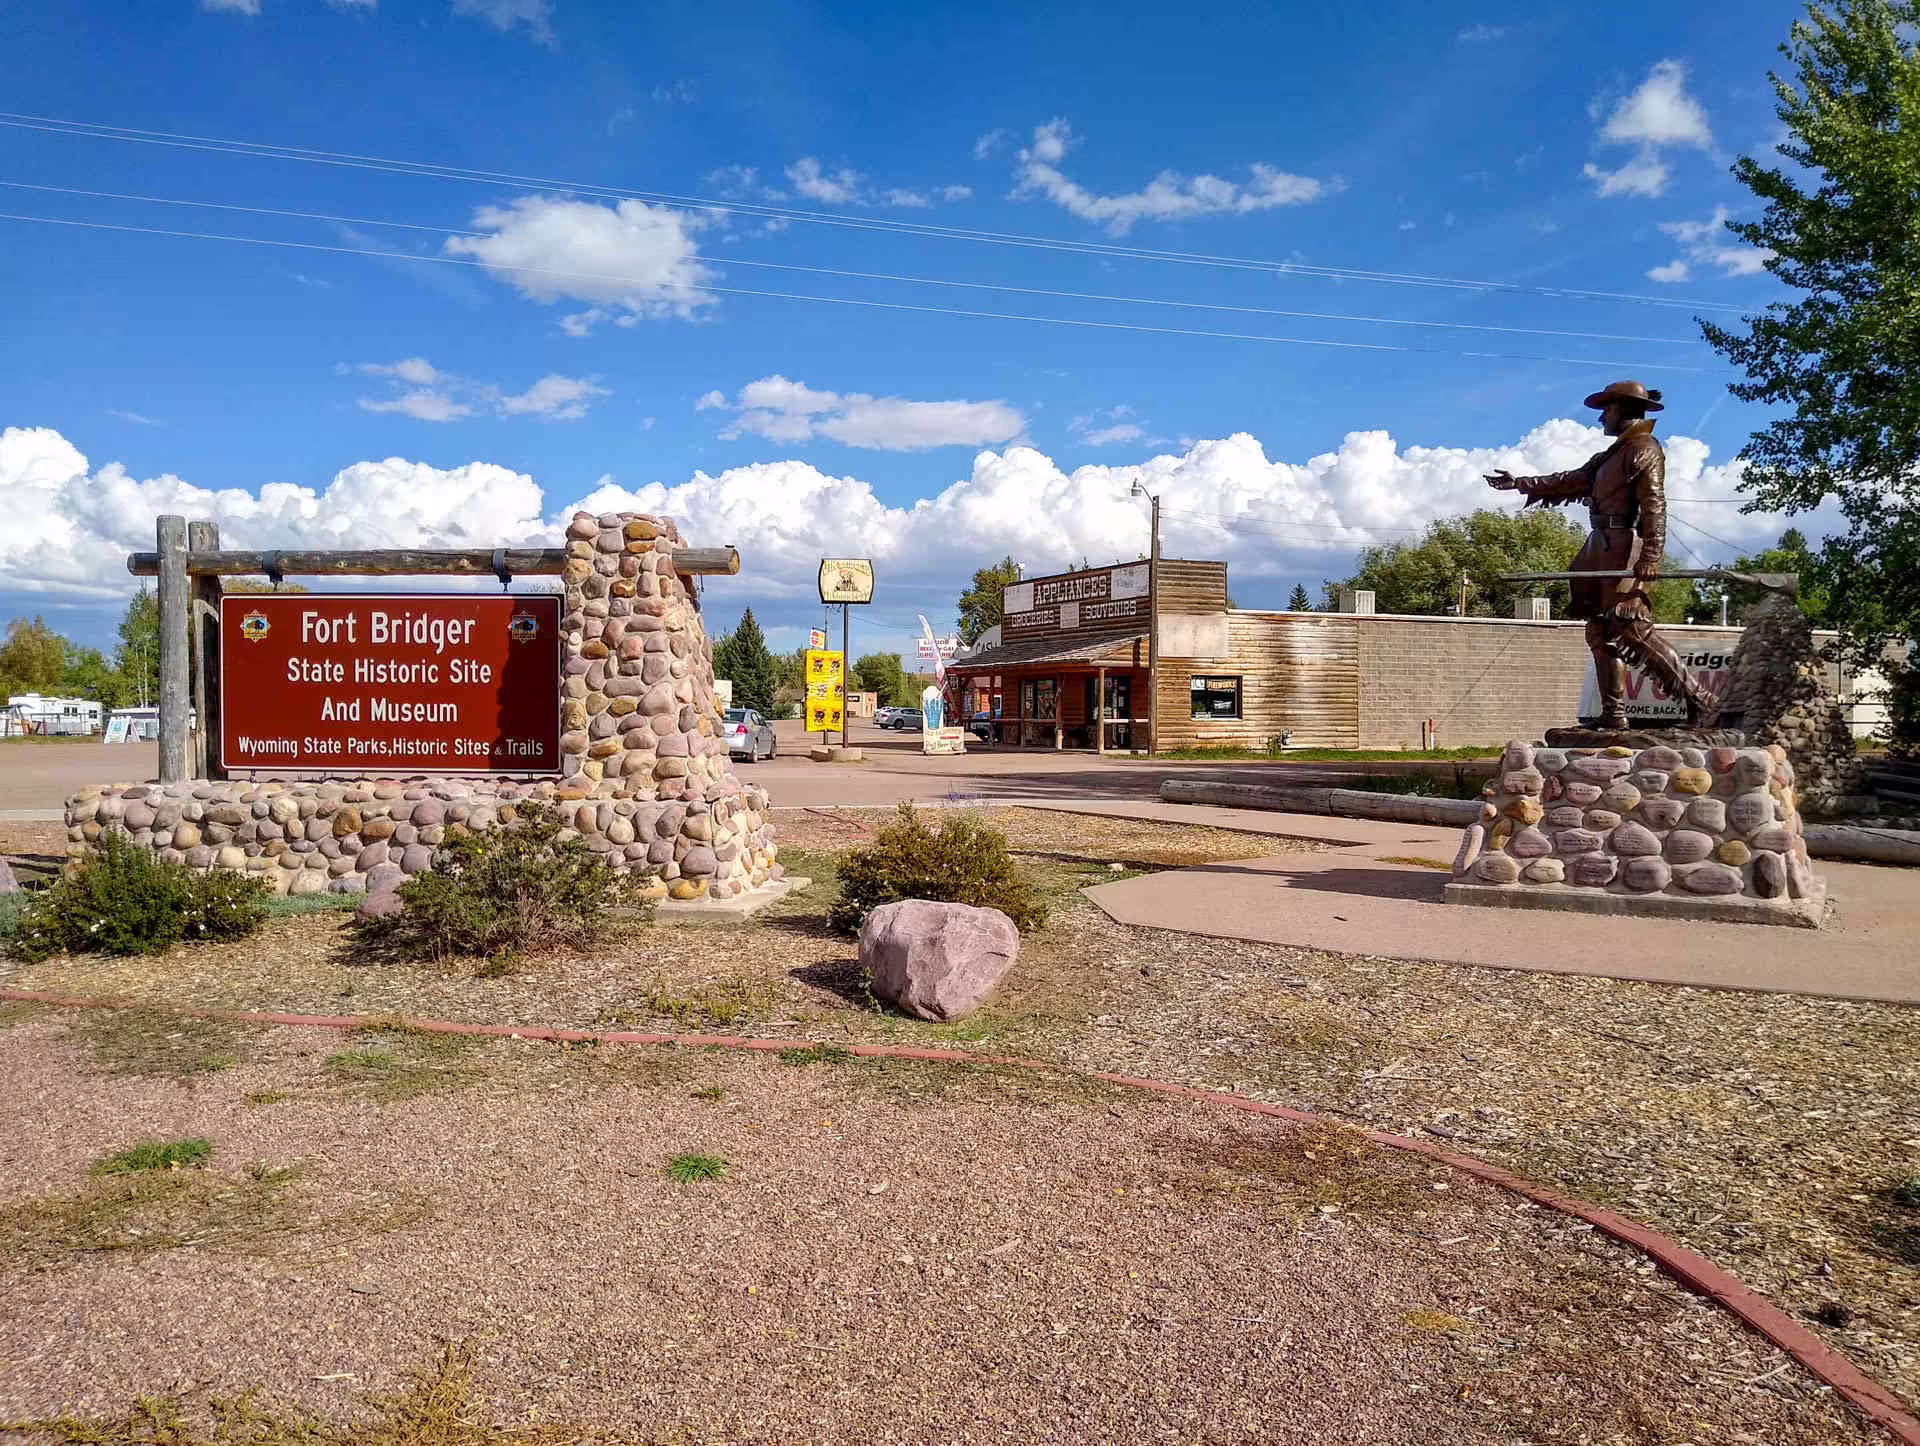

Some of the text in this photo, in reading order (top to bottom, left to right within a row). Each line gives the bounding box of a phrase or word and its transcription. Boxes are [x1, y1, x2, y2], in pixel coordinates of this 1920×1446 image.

[1034, 575, 1108, 605] APPLIANCES
[1011, 609, 1055, 628] GROCERIES
[1085, 600, 1137, 619] SOUVENIRS
[302, 611, 476, 655] Fort Bridger
[287, 657, 492, 684] State Historic Site
[1679, 652, 1732, 670] ridg
[320, 696, 459, 723] And Museum
[1625, 705, 1650, 715] COME
[1653, 705, 1676, 715] BACK
[238, 736, 298, 759] Wyoming
[303, 736, 342, 755] State
[454, 738, 490, 756] Sites
[494, 746, 503, 756] &
[505, 738, 545, 757] Trails
